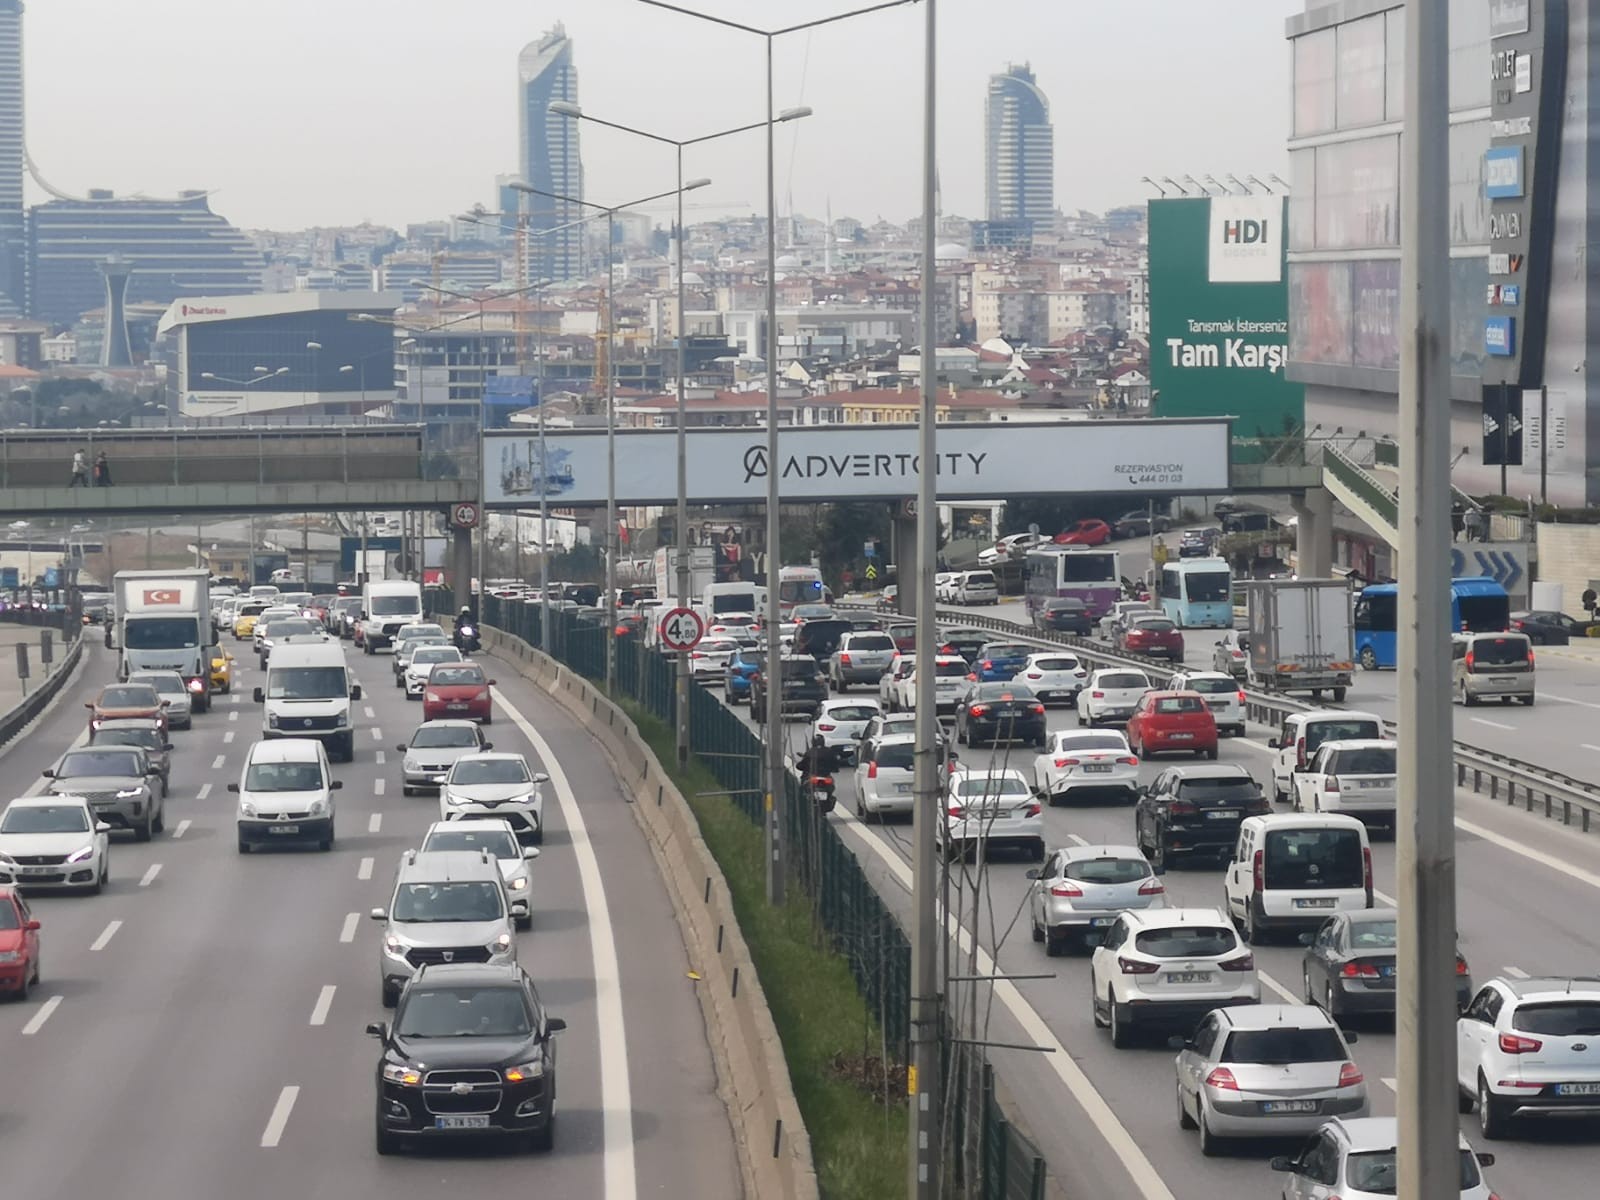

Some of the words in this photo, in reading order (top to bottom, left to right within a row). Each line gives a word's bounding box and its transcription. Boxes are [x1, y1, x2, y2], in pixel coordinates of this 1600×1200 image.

[1223, 220, 1267, 243] HDI
[1187, 319, 1234, 333] Tanışmak
[1167, 338, 1219, 367] Tam
[1114, 464, 1183, 473] REZERVASYON
